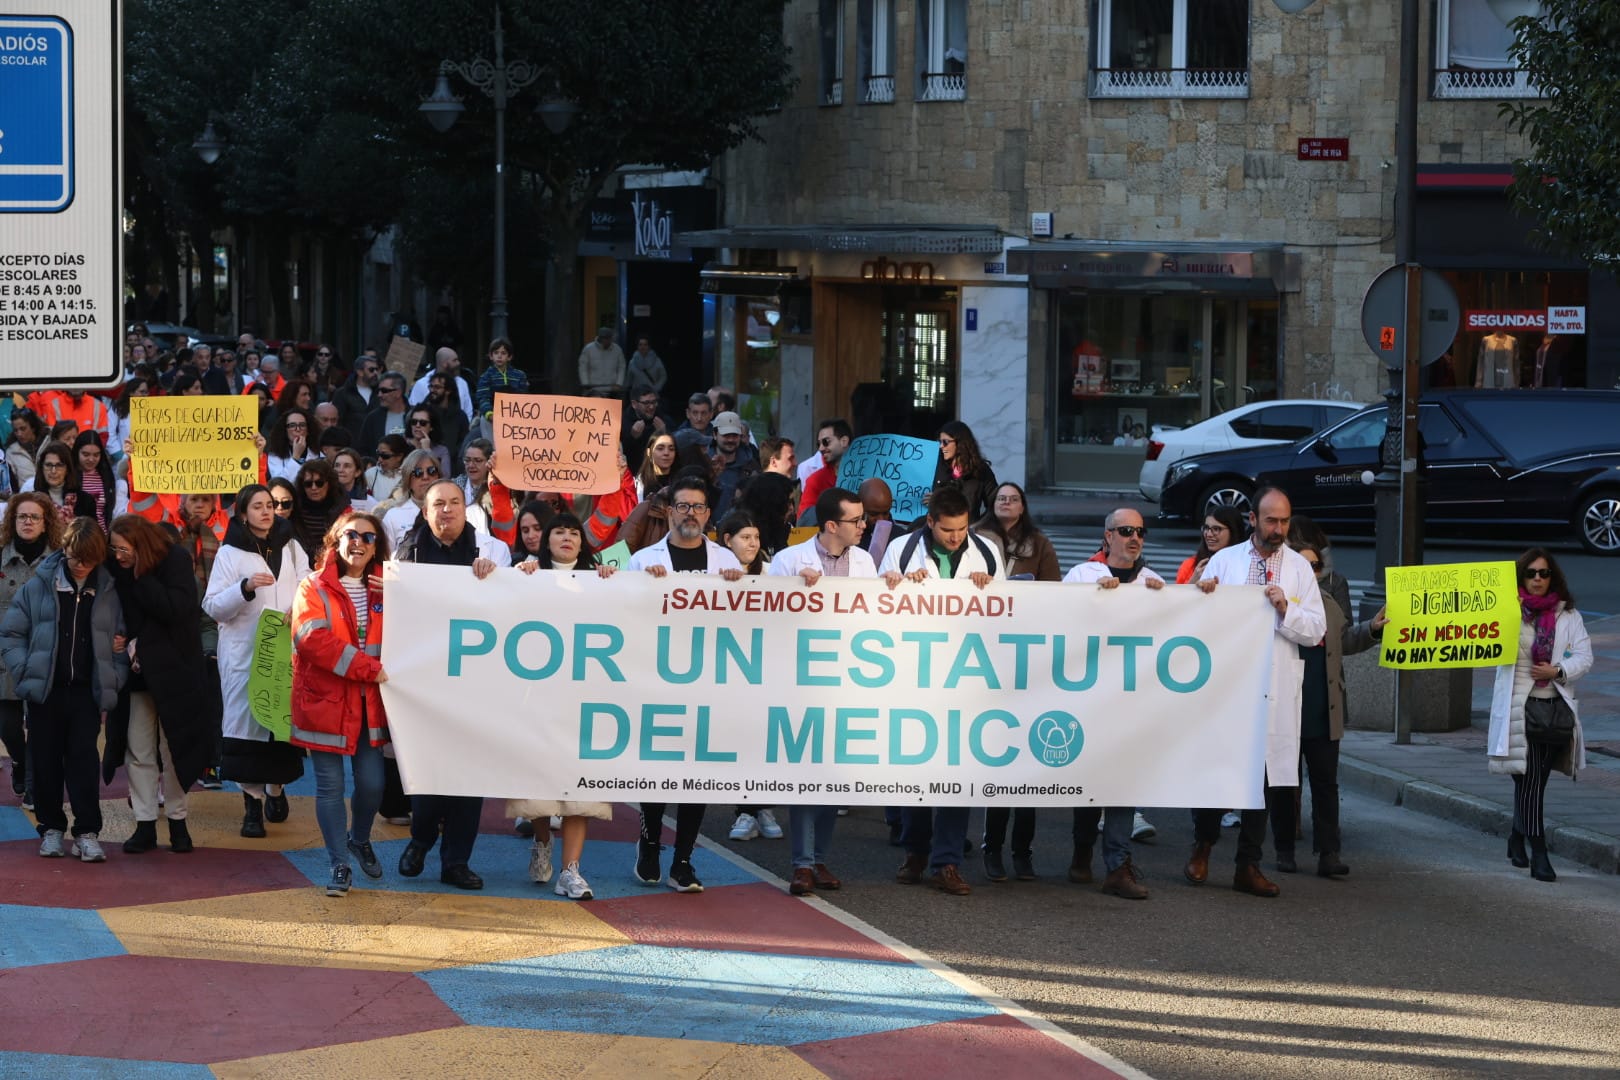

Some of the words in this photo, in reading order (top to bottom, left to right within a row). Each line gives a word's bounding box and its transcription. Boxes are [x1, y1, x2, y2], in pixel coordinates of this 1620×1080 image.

[0, 56, 47, 65] SCOLAR
[54, 252, 85, 266] DÍAS
[14, 285, 40, 295] 8:45
[43, 285, 52, 295] A
[55, 284, 82, 295] 9:00
[11, 300, 44, 310] 14:00
[47, 300, 57, 310] A
[60, 299, 96, 310] 14:15.
[1554, 309, 1579, 317] HASTA
[30, 315, 39, 325] Y
[43, 314, 96, 325] BAJADA
[1469, 314, 1545, 327] SEGUNDAS
[8, 329, 88, 340] ESCOLARES
[138, 408, 172, 424] HORAS
[175, 408, 191, 424] DE
[500, 400, 541, 420] HAGO
[553, 403, 597, 424] HORAS
[601, 410, 612, 426] A
[502, 423, 556, 440] DESTAJO
[567, 429, 576, 442] Y
[587, 432, 611, 446] ME
[511, 445, 562, 462] PAGAN
[572, 450, 599, 463] CON
[849, 437, 924, 460] PEDIMOS
[141, 459, 173, 474] HORAS
[526, 467, 590, 482] VOCACION
[843, 458, 868, 478] QUE
[872, 458, 902, 480] NOS
[1391, 569, 1459, 593] PARAMOS
[1470, 568, 1501, 588] POR
[661, 587, 824, 615] ¡SALVEMOS
[834, 592, 870, 614] LA
[877, 593, 1014, 618] SANIDAD!
[1411, 588, 1497, 615] DIGNIDAD
[1398, 623, 1428, 643] SIN
[1435, 620, 1500, 641] MÉDICOS
[447, 618, 627, 682] POR
[656, 625, 764, 685] UN
[796, 628, 1212, 694] ESTATUTO
[1385, 648, 1407, 664] NO
[1409, 646, 1438, 663] HAY
[1438, 642, 1503, 662] SANIDAD
[578, 702, 738, 762] DEL
[577, 777, 657, 790] Asociación
[661, 778, 678, 790] de
[682, 778, 741, 791] Médicos
[745, 779, 794, 792] Unidos
[799, 782, 822, 795] por
[825, 783, 850, 792] sus
[854, 781, 925, 795] Derechos,
[929, 782, 962, 794] MUD
[982, 782, 1083, 797] @mudmedicos
